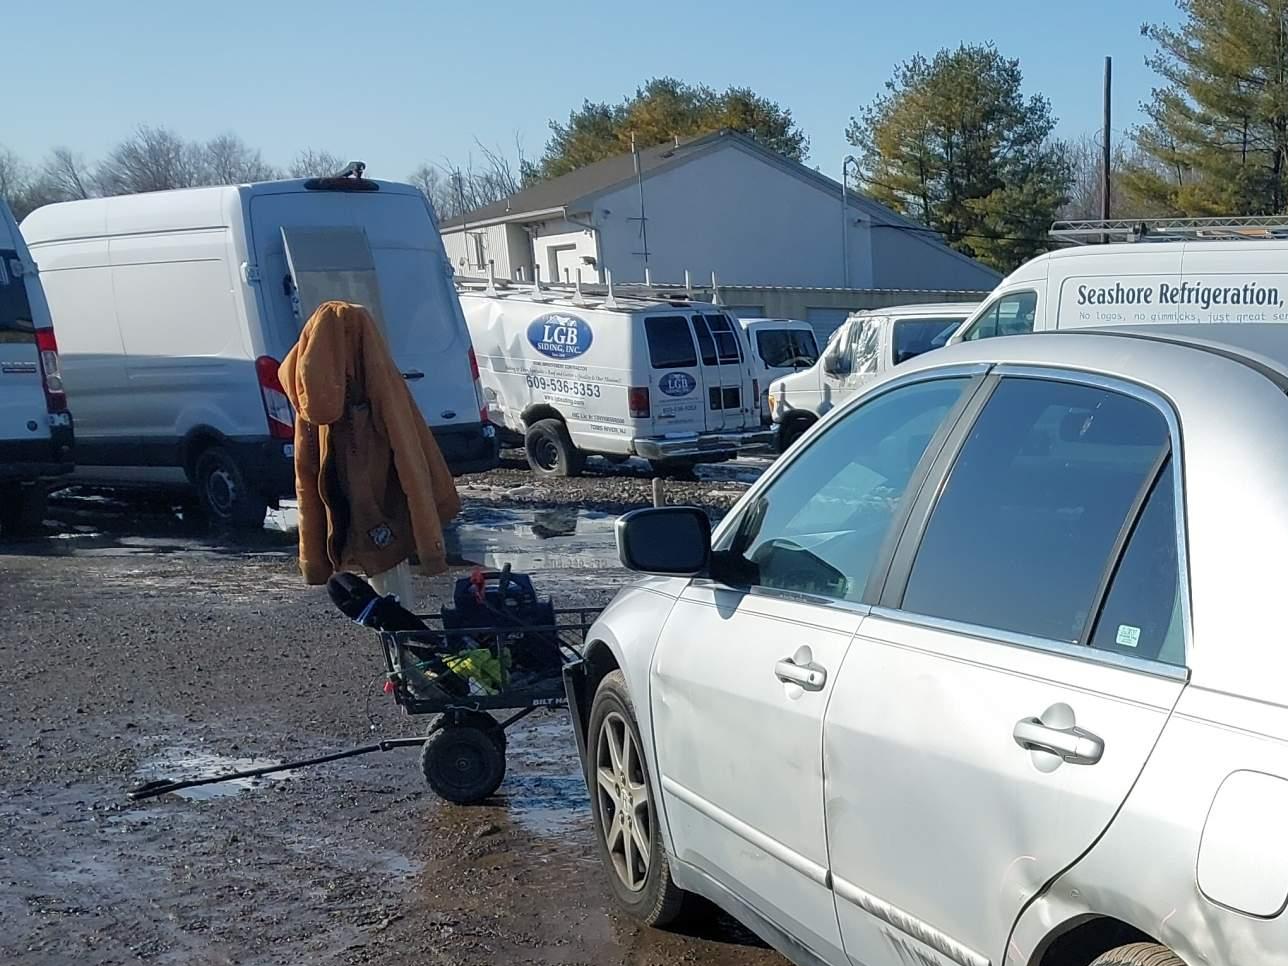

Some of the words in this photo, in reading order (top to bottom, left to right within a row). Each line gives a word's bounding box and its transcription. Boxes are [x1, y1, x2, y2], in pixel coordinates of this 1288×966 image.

[1077, 282, 1153, 305] Seashore
[1159, 281, 1284, 310] Refrigeration,
[1079, 311, 1091, 321] No
[1134, 311, 1146, 321] no
[1207, 311, 1230, 323] just
[1236, 311, 1266, 323] great
[542, 324, 578, 346] LGB
[536, 342, 566, 354] SIDING,
[526, 374, 601, 399] 609-536-5353
[667, 378, 689, 390] LGB
